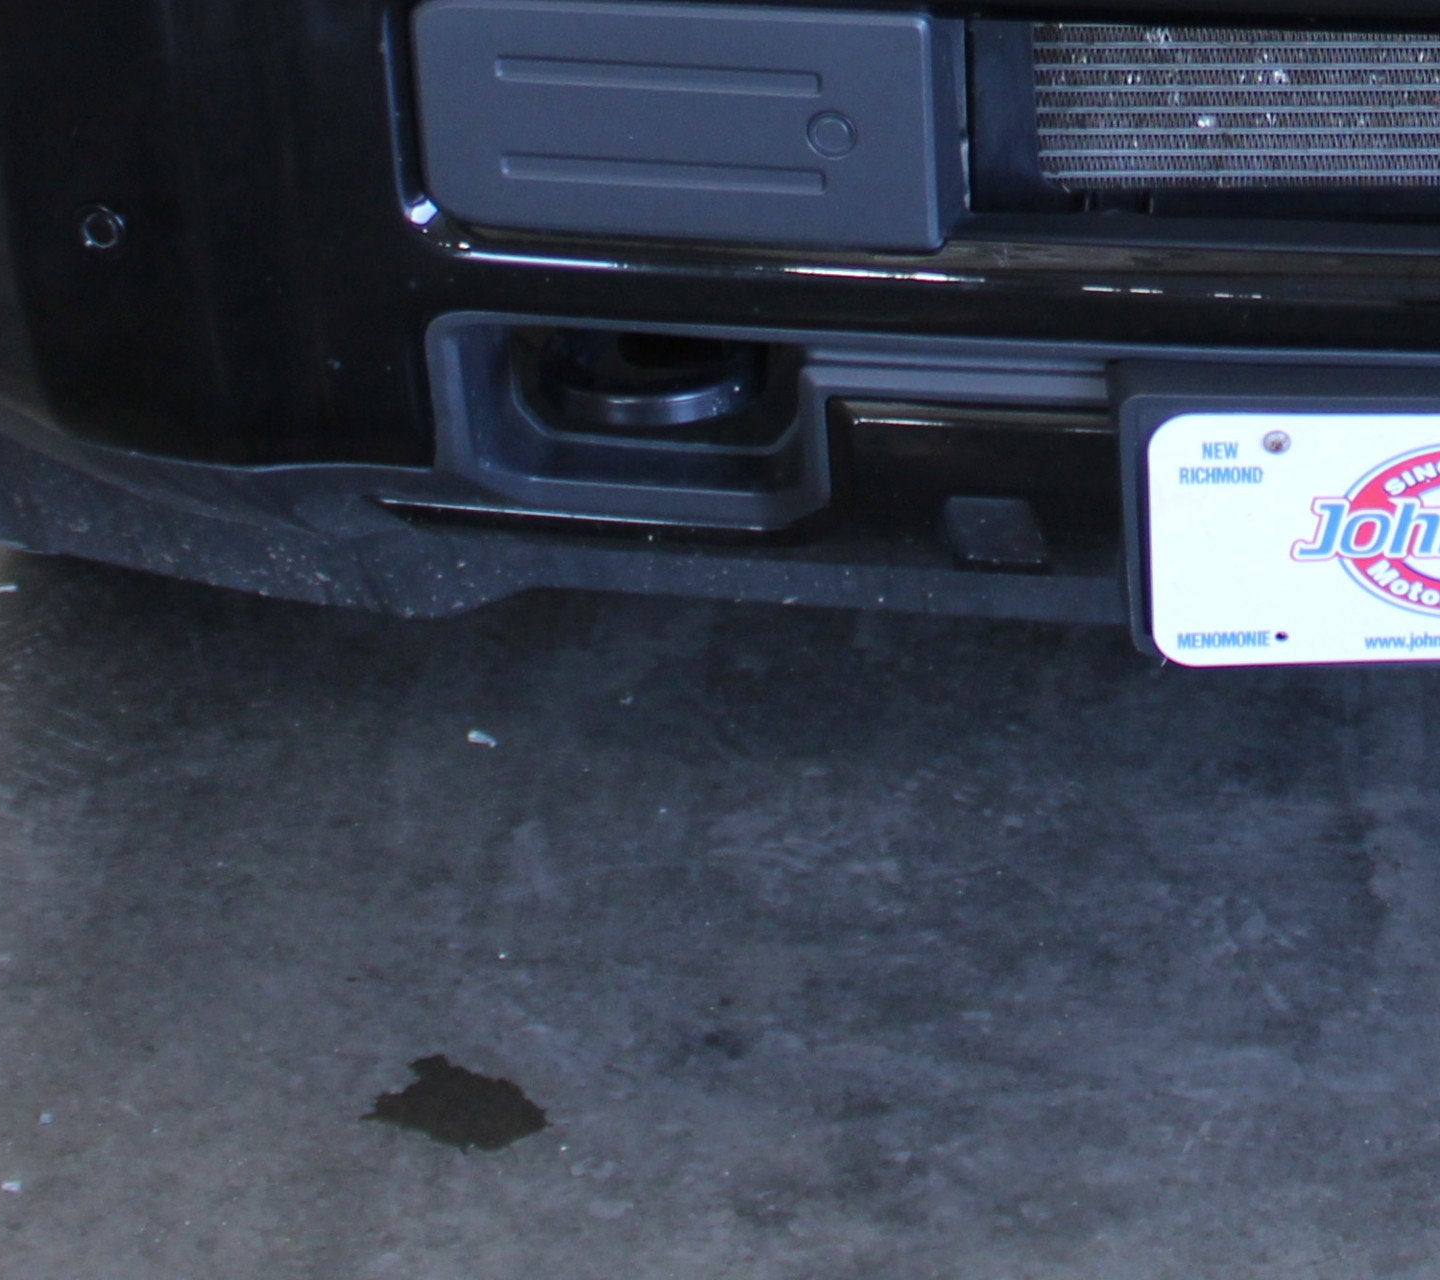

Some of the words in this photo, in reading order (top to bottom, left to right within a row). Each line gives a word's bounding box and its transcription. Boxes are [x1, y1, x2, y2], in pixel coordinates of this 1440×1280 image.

[1202, 441, 1239, 460] NEW
[1179, 467, 1264, 485] RICHMOND
[1177, 631, 1271, 649] MENOMONIE
